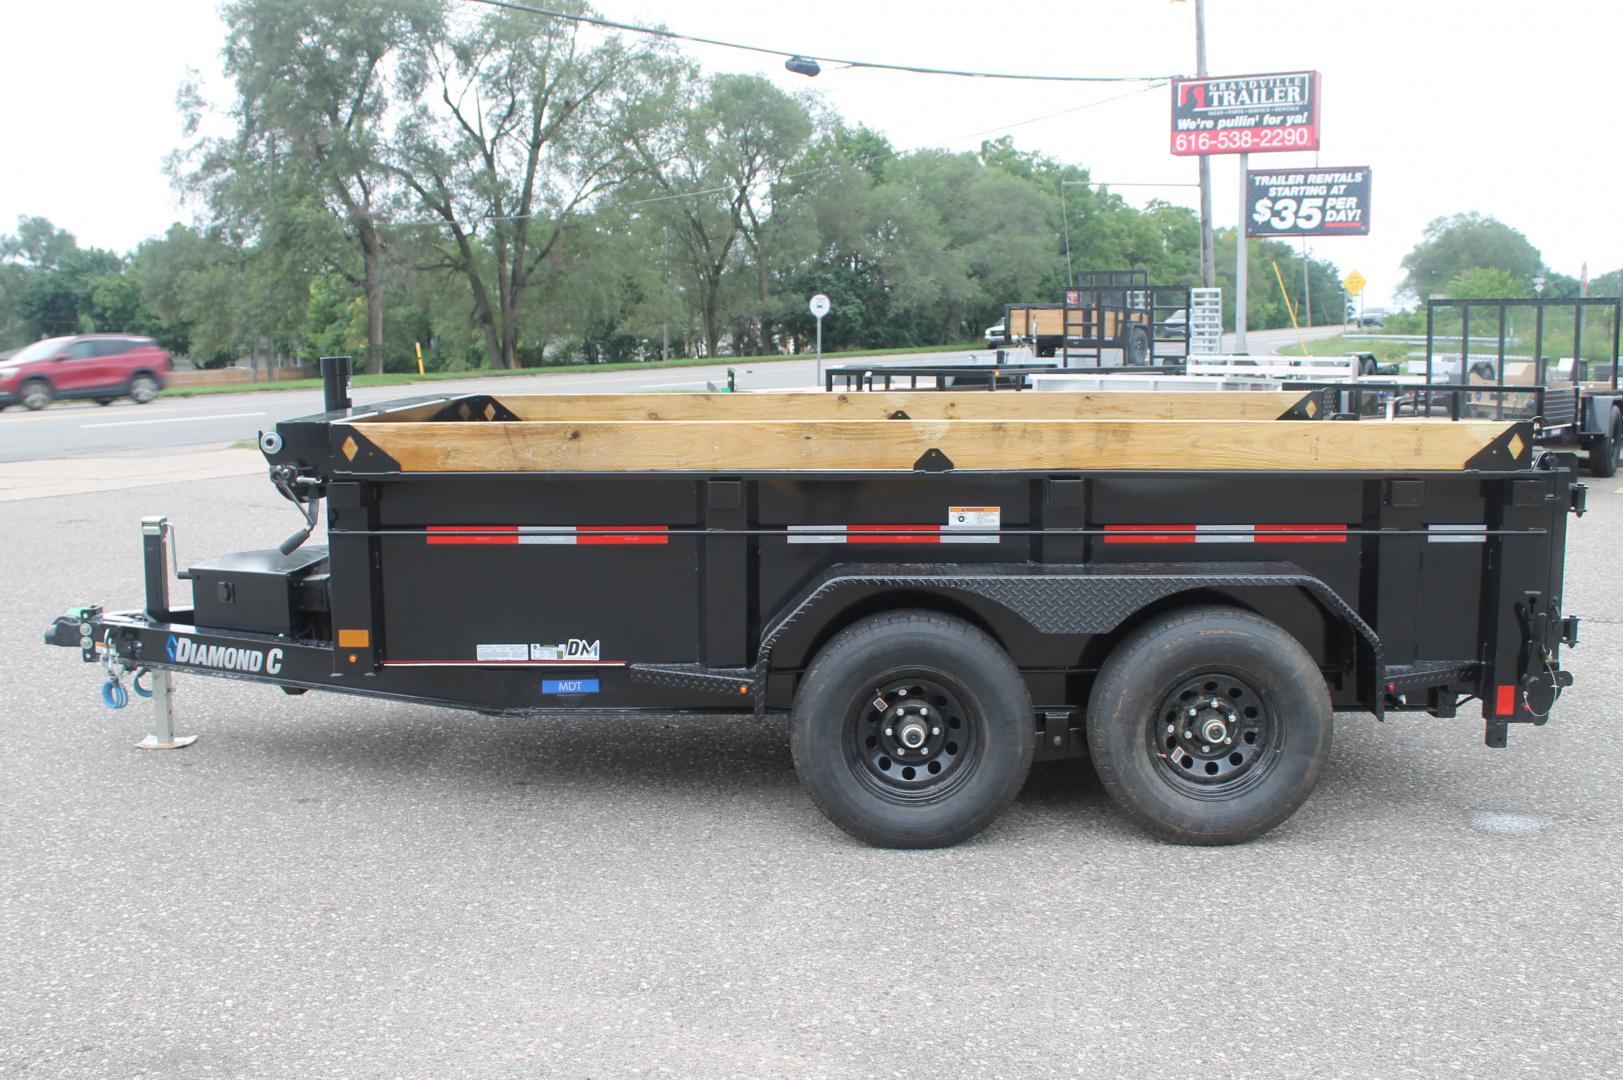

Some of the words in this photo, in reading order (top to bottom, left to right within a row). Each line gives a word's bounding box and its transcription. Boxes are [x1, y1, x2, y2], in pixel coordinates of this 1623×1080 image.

[1209, 77, 1302, 91] GRANDVILLE
[1208, 86, 1302, 107] TRAILER
[1177, 116, 1214, 131] We're
[1217, 114, 1260, 132] pullin'
[1262, 113, 1283, 126] for
[1285, 112, 1308, 126] ya!
[1175, 127, 1308, 151] 616-538-2290
[1254, 174, 1304, 186] TRAILER
[1307, 172, 1362, 184] RENTALS
[1268, 185, 1327, 197] STARTING
[1329, 184, 1347, 195] AT
[1325, 196, 1358, 209] PER
[1252, 196, 1324, 230] $35
[1325, 209, 1361, 222] DAY!
[175, 637, 263, 672] DIAMOND
[266, 648, 283, 675] C
[558, 681, 582, 692] MDT
